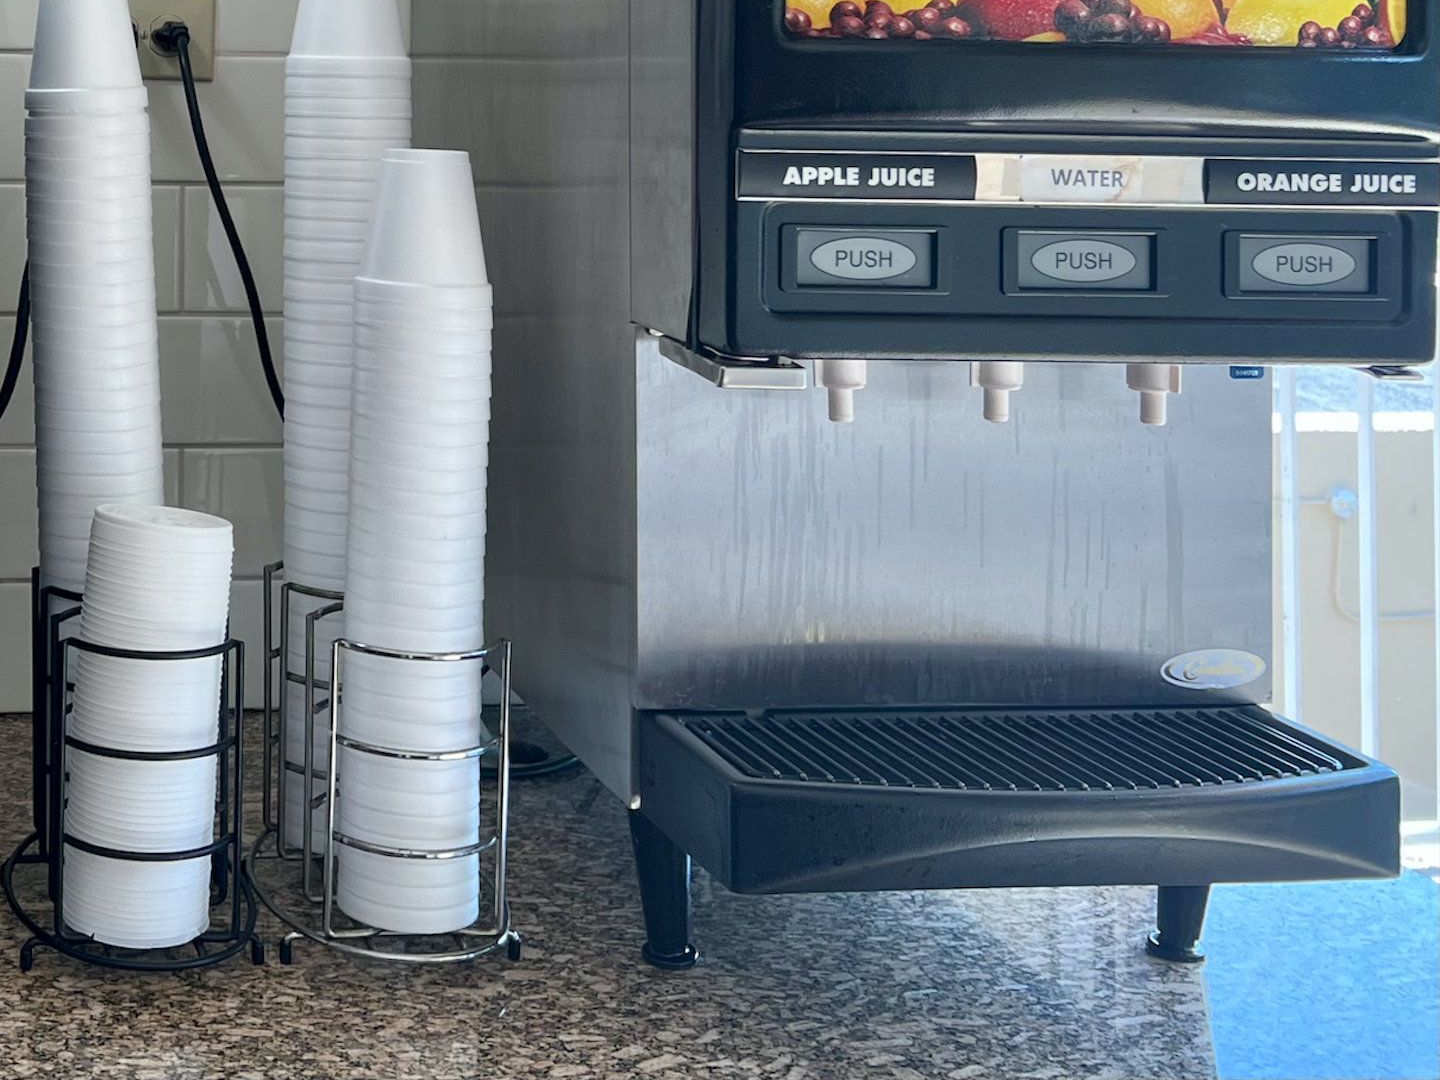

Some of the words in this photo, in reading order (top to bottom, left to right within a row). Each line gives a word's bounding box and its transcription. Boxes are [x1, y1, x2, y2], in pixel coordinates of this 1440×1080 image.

[782, 166, 859, 186] APPLE
[867, 167, 935, 187] JUICE
[1051, 169, 1124, 188] WATER
[1236, 172, 1342, 194] ORANGE
[1348, 173, 1416, 195] JUICE
[835, 250, 893, 268] PUSH
[1055, 252, 1112, 270] PUSH
[1276, 256, 1333, 273] PUSH
